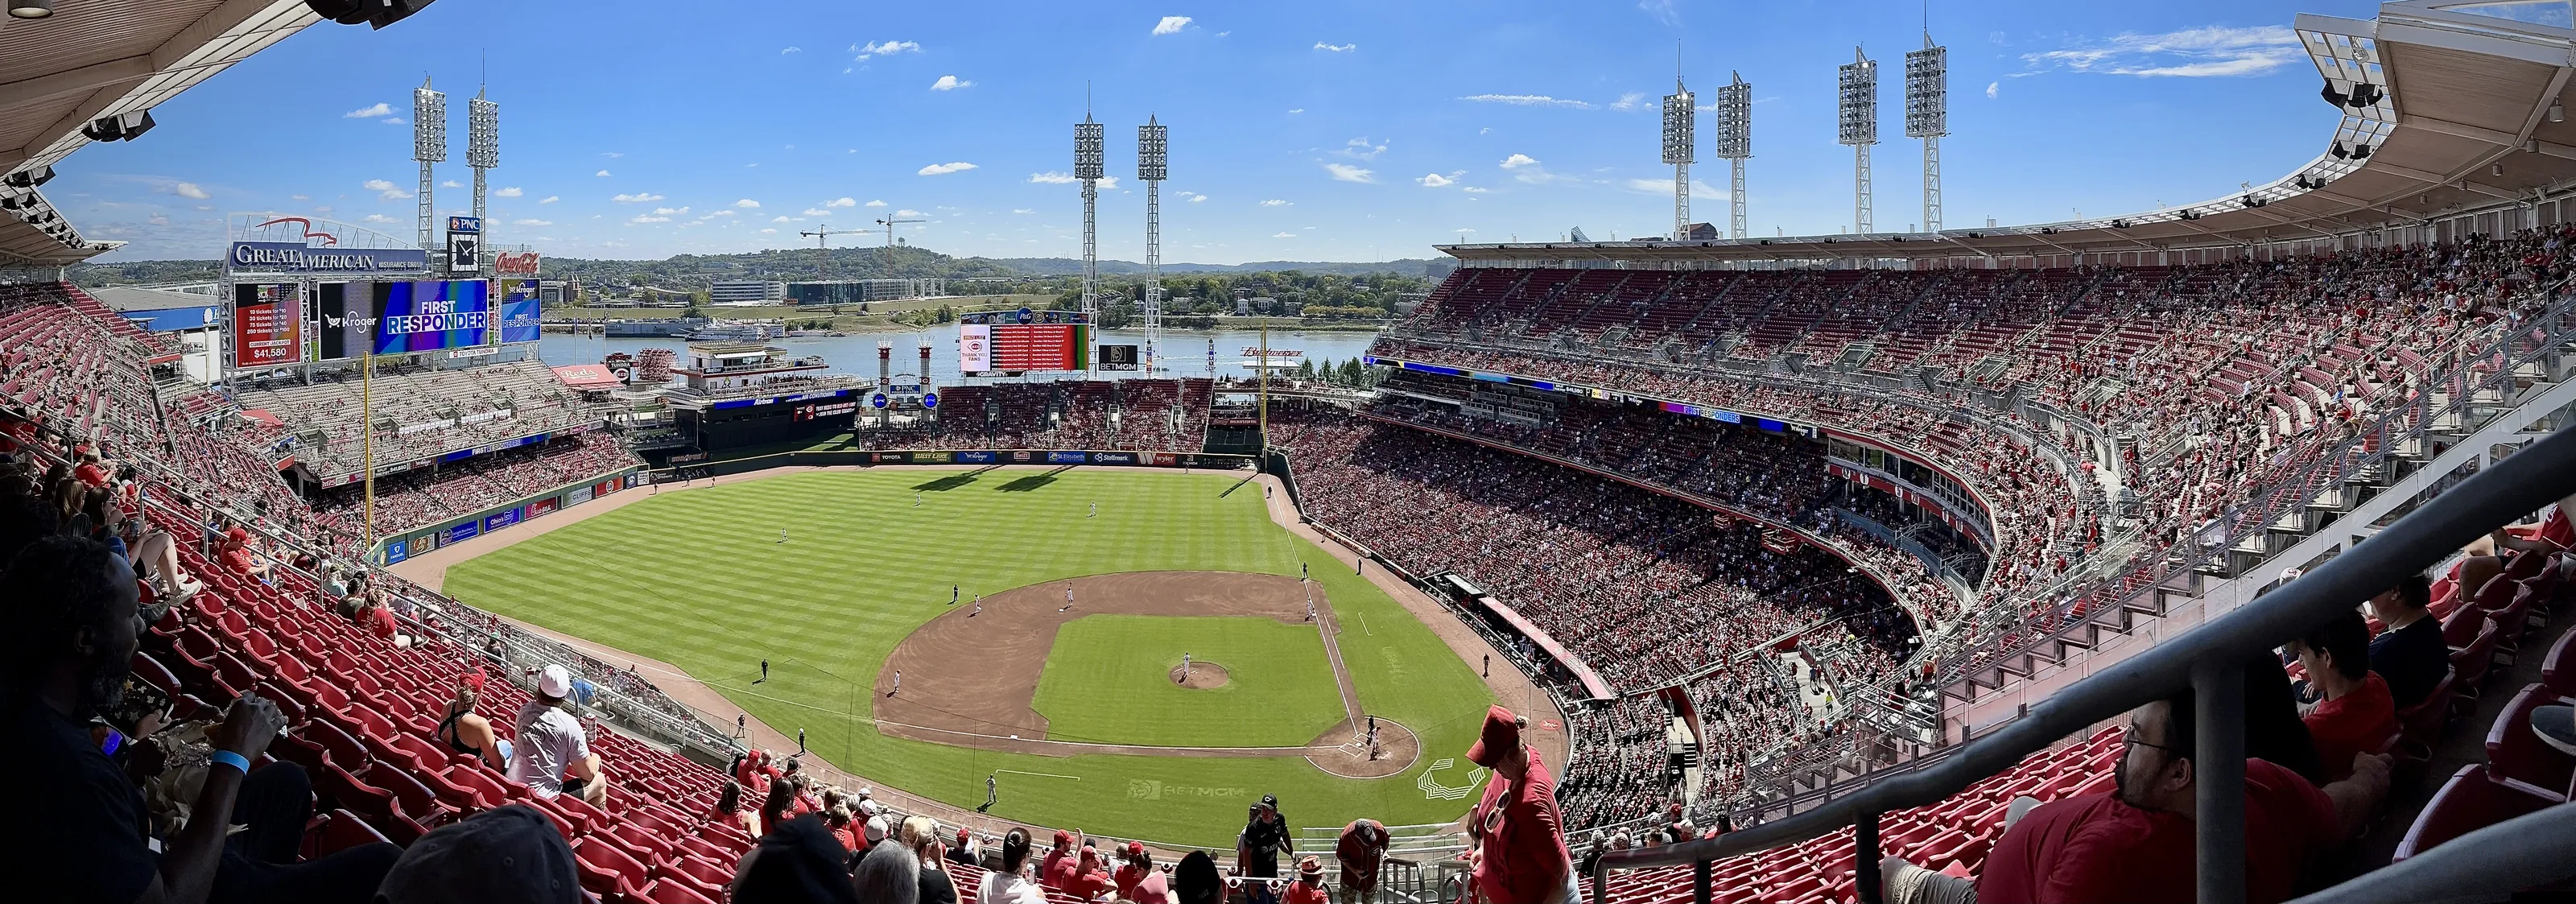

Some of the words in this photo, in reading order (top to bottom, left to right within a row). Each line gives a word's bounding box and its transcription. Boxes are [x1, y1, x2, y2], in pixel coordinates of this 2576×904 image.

[460, 219, 480, 229] PNC
[236, 244, 297, 264] GREAT
[293, 250, 375, 269] AMERICAN
[421, 300, 456, 315] FIRST
[342, 310, 377, 334] Kroger
[388, 312, 486, 334] RESPONDER
[503, 318, 540, 328] RESPONDER
[254, 348, 287, 359] $41,580
[477, 348, 495, 356] TUNDRA
[560, 369, 599, 379] Reds
[753, 398, 774, 406] Airtron
[1683, 406, 1700, 415] FIRST
[1700, 408, 1740, 423] RESPONDERS
[472, 447, 488, 456] FIRST
[487, 440, 521, 453] RESPONDERS
[572, 489, 592, 501] CLIFFS
[490, 517, 504, 525] Ohio's
[1164, 786, 1246, 797] BETMGM
